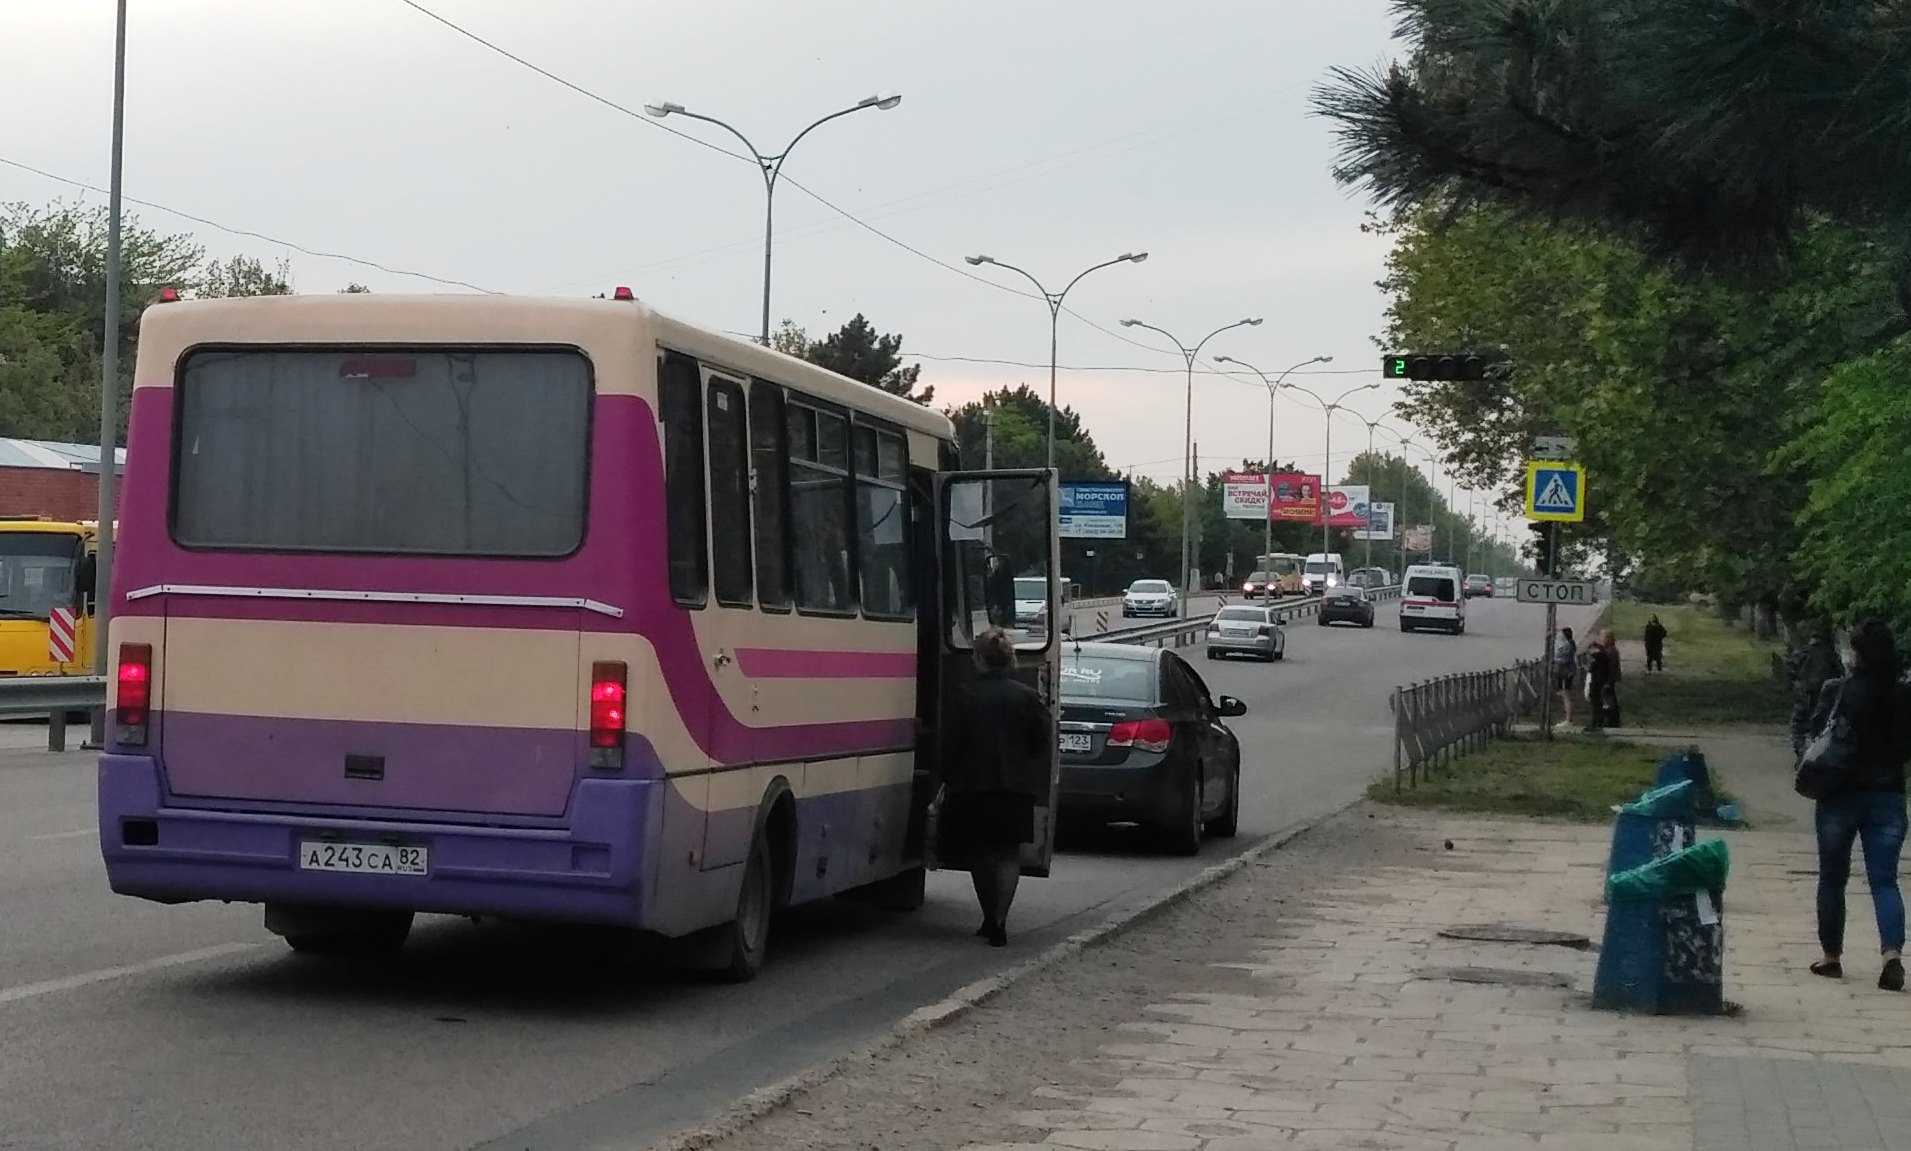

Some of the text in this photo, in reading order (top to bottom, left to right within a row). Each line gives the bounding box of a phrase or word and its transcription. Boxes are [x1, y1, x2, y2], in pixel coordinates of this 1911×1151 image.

[1395, 360, 1405, 374] 2
[1527, 583, 1584, 600] СТОП
[399, 848, 420, 866] 82
